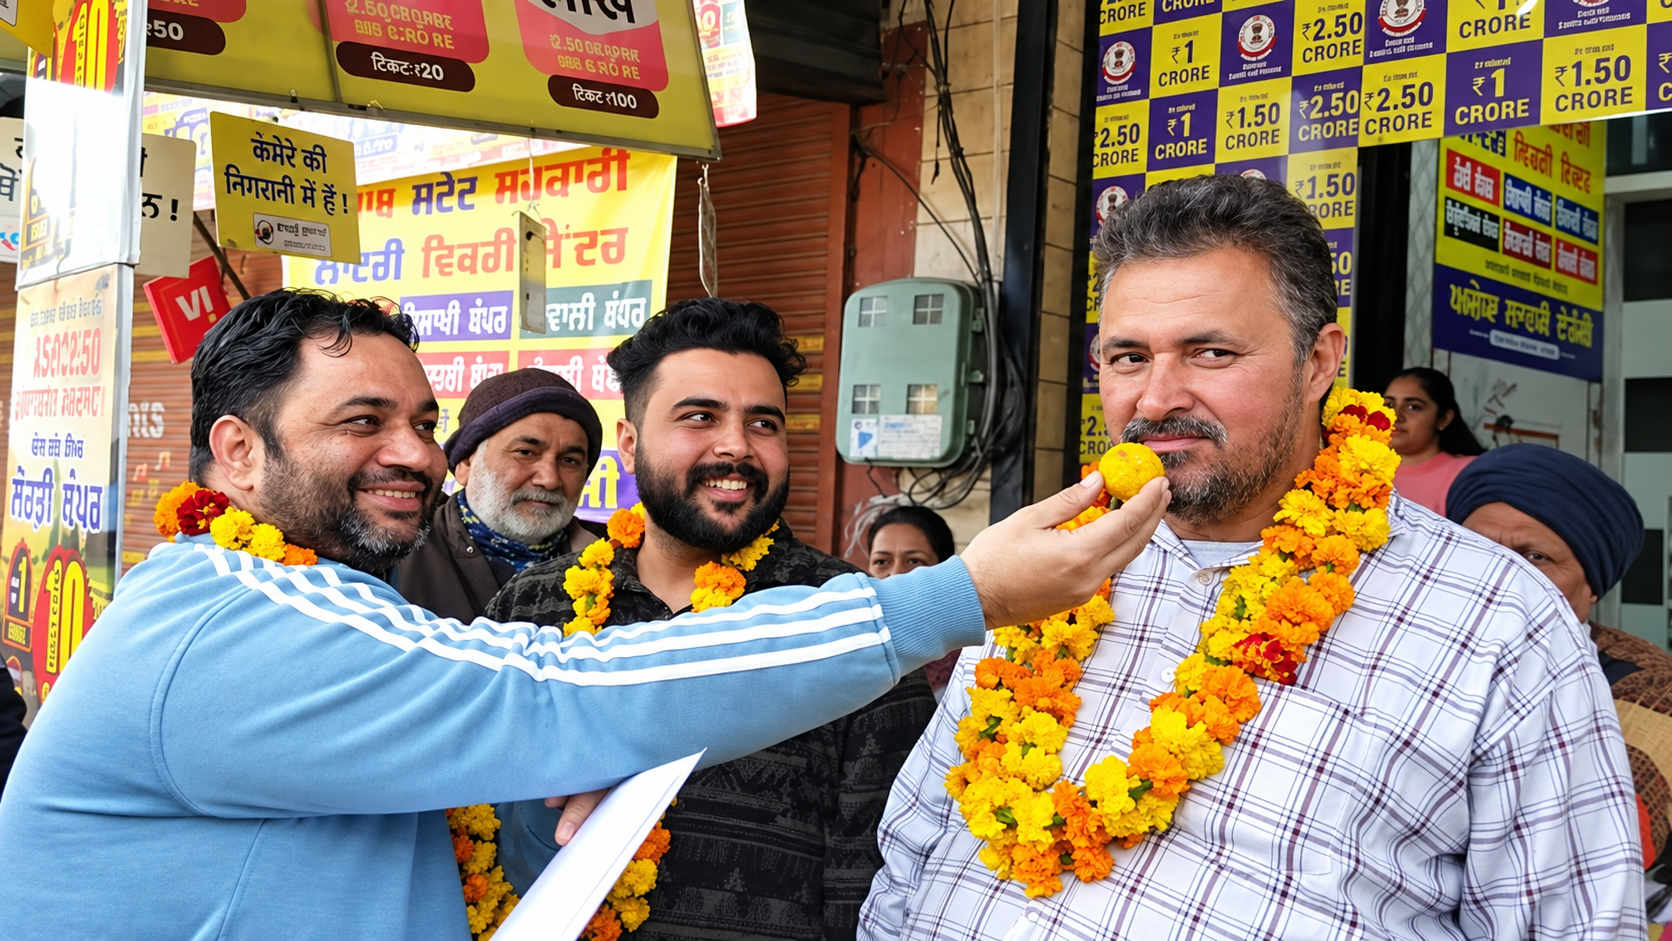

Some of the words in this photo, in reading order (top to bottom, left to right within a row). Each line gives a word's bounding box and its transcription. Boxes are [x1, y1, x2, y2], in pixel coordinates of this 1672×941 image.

[1099, 2, 1146, 24] CRORE
[1162, 0, 1214, 13] CRO
[1302, 12, 1363, 42] ₹2.50
[1459, 12, 1531, 39] CRORE
[1302, 39, 1362, 64] CRORE
[1158, 65, 1210, 88] CRORE
[1555, 55, 1631, 87] ₹1.50
[1299, 90, 1359, 119] ₹2.50
[1364, 81, 1433, 113] ₹2.50
[1555, 86, 1633, 112] CRORE
[1226, 102, 1280, 129] ₹1.50
[1364, 111, 1432, 135] CRORE
[1455, 98, 1529, 125] CRORE
[1225, 128, 1280, 150] CRORE
[1298, 118, 1359, 142] CRORE
[301, 144, 327, 174] की
[1092, 148, 1139, 167] CRORE
[1155, 138, 1208, 160] CRORE
[224, 163, 295, 205] निगरानी
[300, 178, 317, 208] में
[411, 171, 479, 216] ਸਟੇਟ
[1295, 172, 1356, 200] ₹1.50
[1309, 200, 1354, 219] RORE
